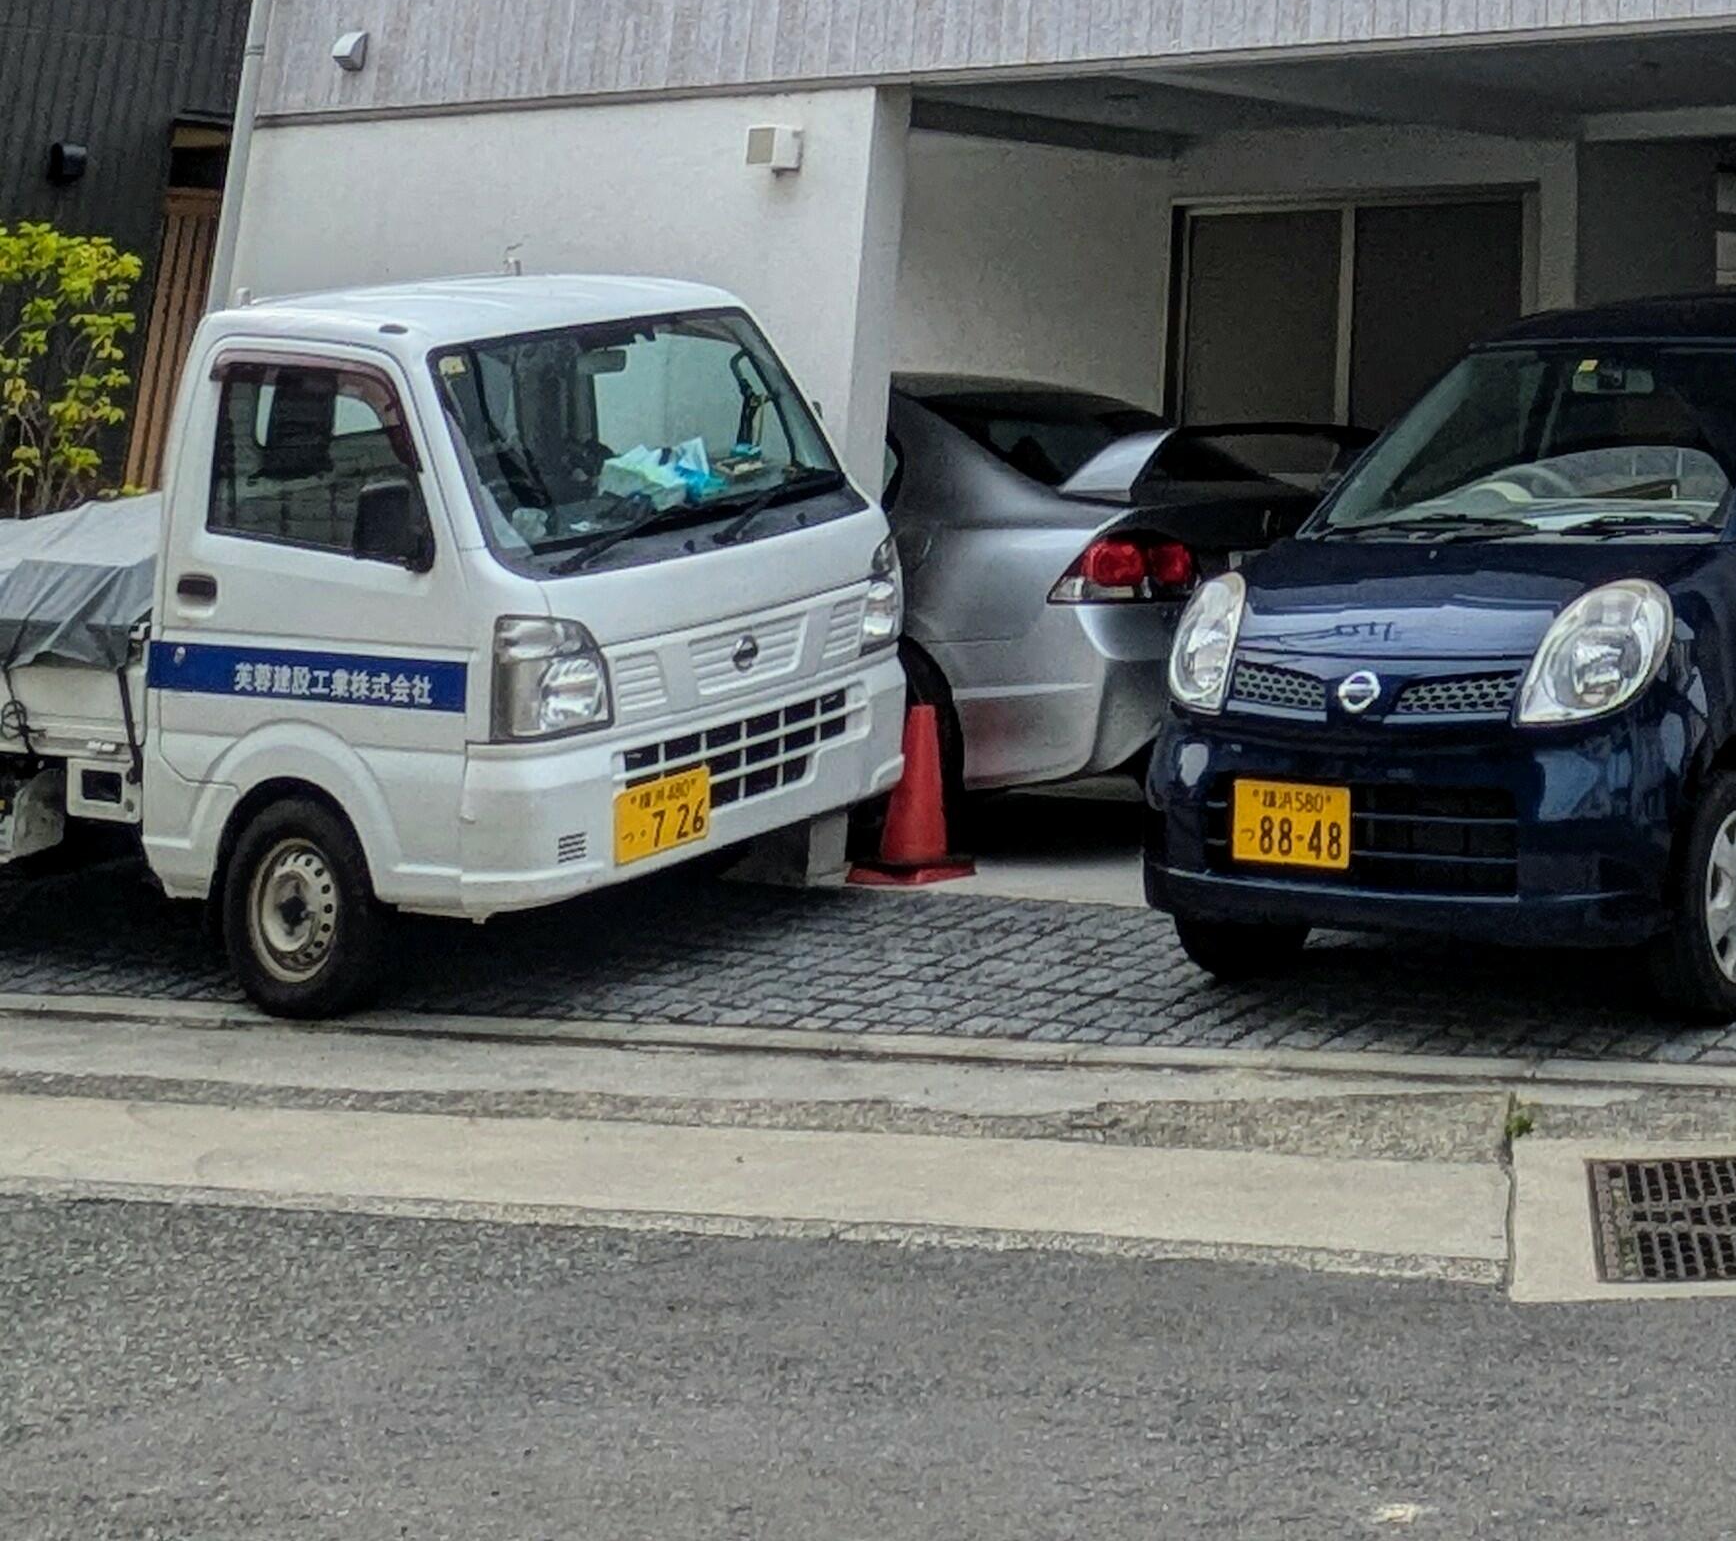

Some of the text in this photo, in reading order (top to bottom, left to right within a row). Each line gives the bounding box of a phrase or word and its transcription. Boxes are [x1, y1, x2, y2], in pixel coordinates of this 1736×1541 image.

[233, 661, 433, 705] 芙蓉建設工業株式会社
